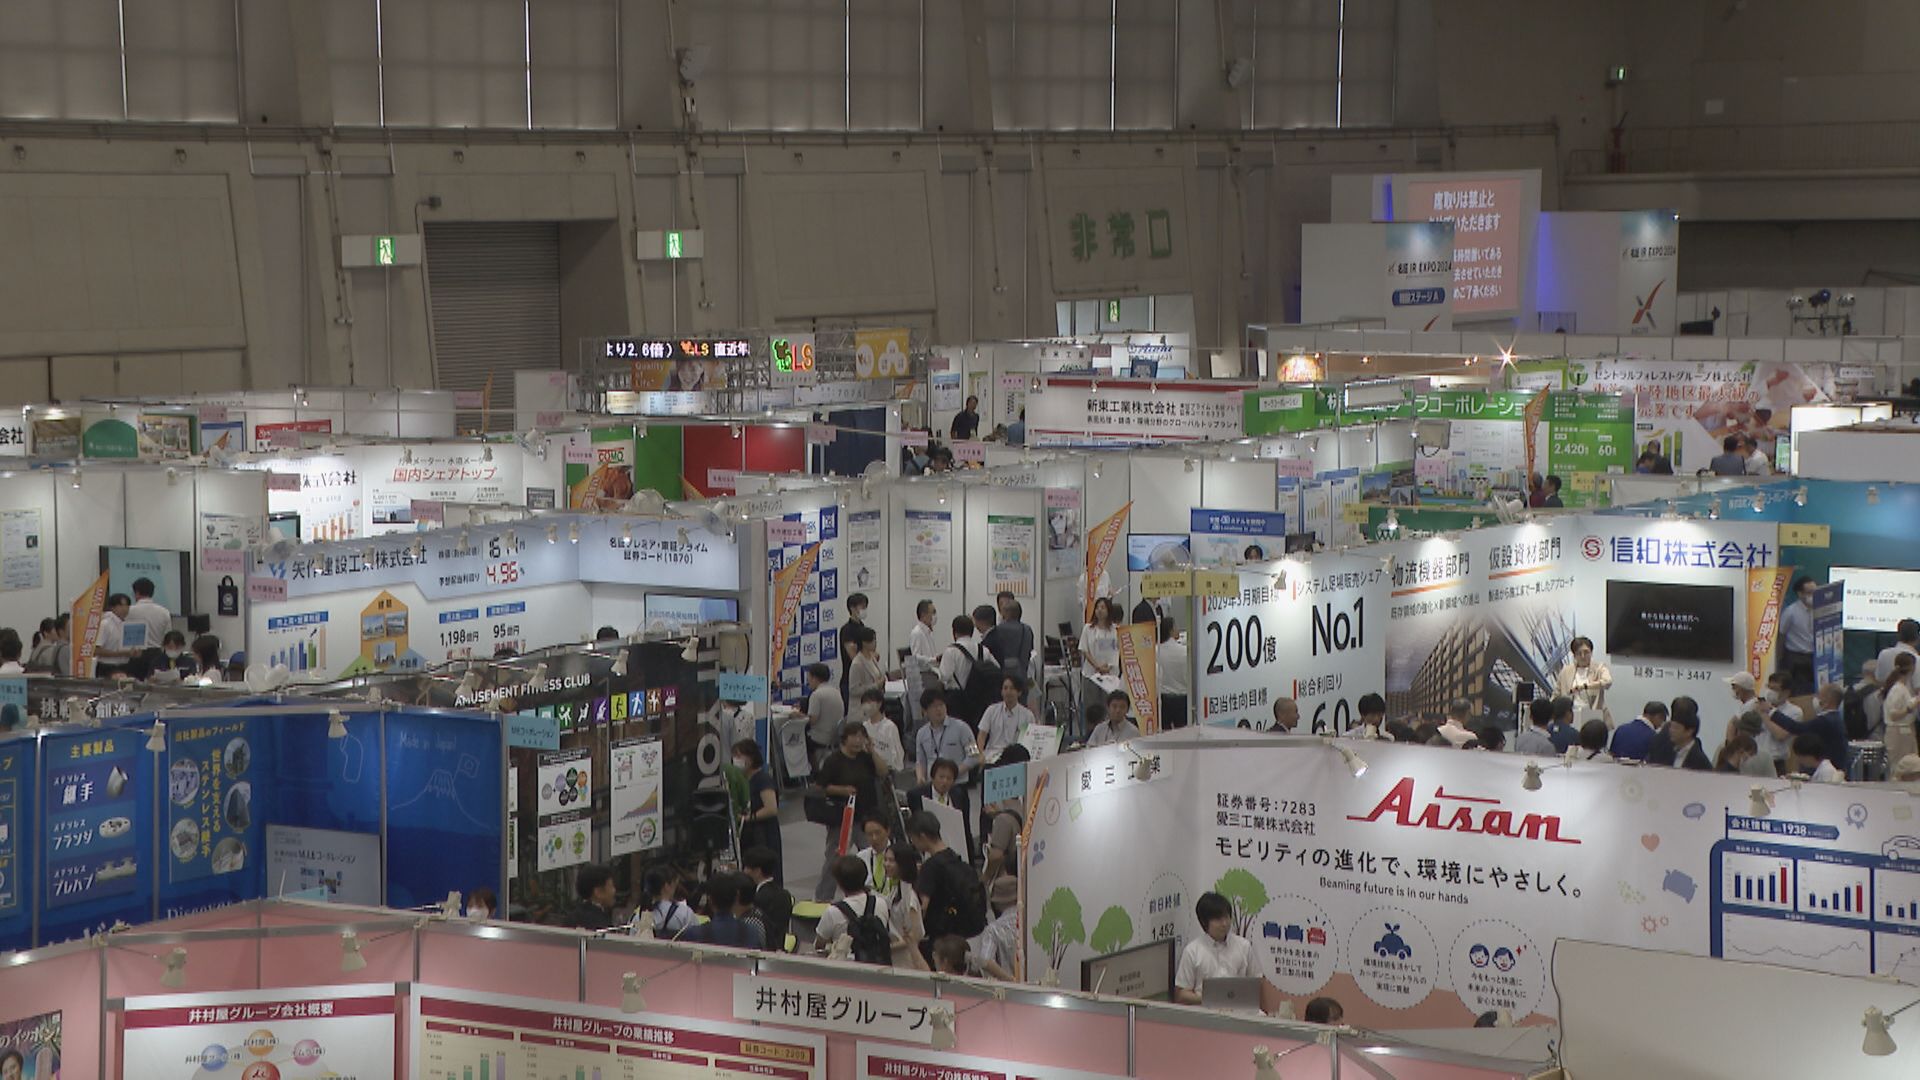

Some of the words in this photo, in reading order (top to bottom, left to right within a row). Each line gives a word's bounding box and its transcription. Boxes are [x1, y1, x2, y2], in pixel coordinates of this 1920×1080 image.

[1069, 209, 1171, 262] 非常口
[1086, 399, 1177, 417] 新東工業株式会社
[392, 466, 498, 483] 国内シェアトップ
[623, 550, 693, 565] 証券コード(1870)
[1488, 537, 1562, 571] 仮設資材部門
[1610, 536, 1771, 569] 信和株式会社
[1297, 569, 1383, 597] システム足場販売シェア
[1391, 552, 1470, 588] 物流機器部門
[440, 628, 479, 648] 1,198億円
[493, 622, 520, 638] 95億円
[1312, 596, 1364, 656] No.1
[1206, 614, 1277, 676] 200億
[1299, 672, 1343, 698] 総合利回り
[1633, 665, 1684, 680] 証券コード
[1687, 670, 1712, 681] 3447
[455, 685, 519, 708] AMUSEMENT
[564, 673, 591, 688] CLUB
[1208, 687, 1268, 714] 配当性向目標
[71, 740, 114, 758] 主要製品
[1216, 792, 1317, 816] 証券番号:7283
[1346, 776, 1582, 845] Aisan
[1216, 811, 1317, 837] 愛三工業株式会社
[1781, 822, 1807, 836] 1938
[53, 829, 94, 851] フランジ
[1215, 836, 1582, 899] モビリティの進化で、環境にやさしく。
[54, 875, 95, 898] プレハブ
[1319, 876, 1361, 895] Beaming
[1363, 880, 1394, 896] future
[1396, 883, 1405, 896] is
[1407, 886, 1416, 898] in
[1418, 888, 1436, 900] our
[1438, 888, 1469, 904] hands
[1359, 968, 1428, 985] カーボンニュートラルの
[1363, 957, 1423, 973] 環境技術を活かして
[188, 1001, 334, 1024] 井村屋グループ会社概要
[755, 985, 929, 1032] 井村屋グループ
[552, 1015, 675, 1045] 井村屋グループの業績推移
